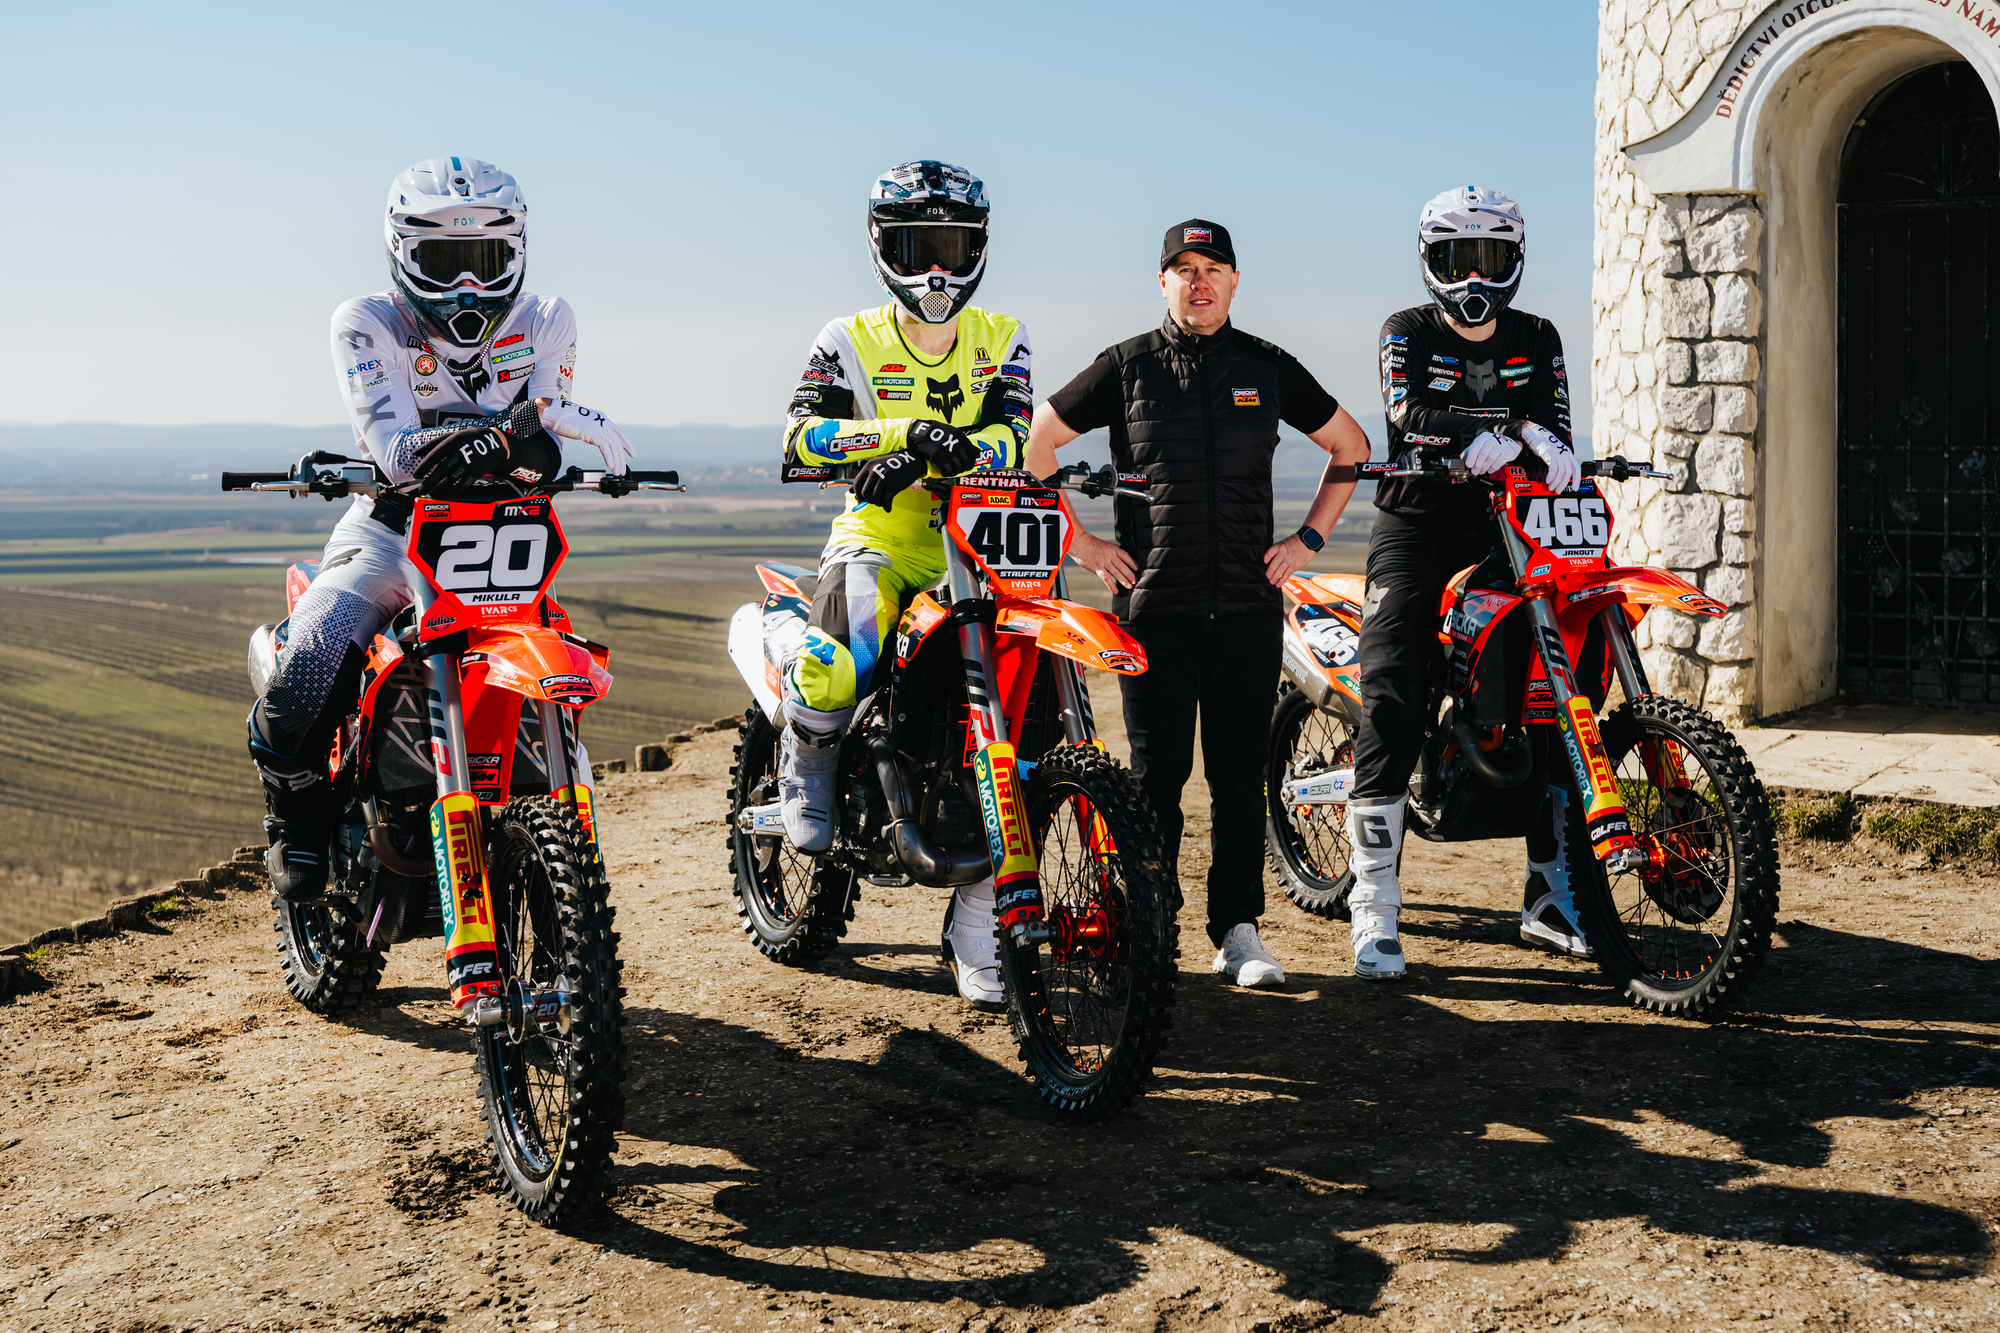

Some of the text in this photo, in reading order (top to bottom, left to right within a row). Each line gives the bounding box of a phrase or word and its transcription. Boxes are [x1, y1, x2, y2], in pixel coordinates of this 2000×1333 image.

[1716, 18, 1780, 120] DĚDICTVÍ
[926, 207, 945, 215] FOX
[453, 218, 475, 226] FOX
[493, 334, 524, 349] KTM
[501, 348, 532, 362] MOTOREX
[1506, 357, 1527, 365] KTM
[347, 359, 384, 378] SOREX
[879, 364, 907, 372] KTM
[413, 384, 439, 393] Julius
[561, 400, 606, 427] FOX
[915, 422, 959, 452] FOX
[1537, 427, 1568, 455] FOX
[459, 433, 500, 464] FOX
[872, 451, 915, 480] FOX
[959, 477, 1028, 488] RENTHAL
[990, 496, 1010, 504] ADAC
[1021, 497, 1056, 507] MXGP
[504, 505, 541, 517] MX2
[1522, 497, 1609, 547] 466
[966, 511, 1061, 566] 401
[435, 524, 549, 591] 20
[1000, 570, 1049, 578] STAUFFER
[472, 593, 521, 602] MIKULA
[425, 614, 456, 629] Julius
[538, 610, 565, 620] Jlius
[550, 685, 591, 695] KTM
[1574, 708, 1618, 795] PIRLLI
[1563, 731, 1594, 800] MOTOREX
[992, 757, 1031, 857] PIRELLI
[980, 780, 1004, 861] MOTOREX
[433, 838, 455, 929] MOTOREX
[536, 1001, 559, 1017] 20
